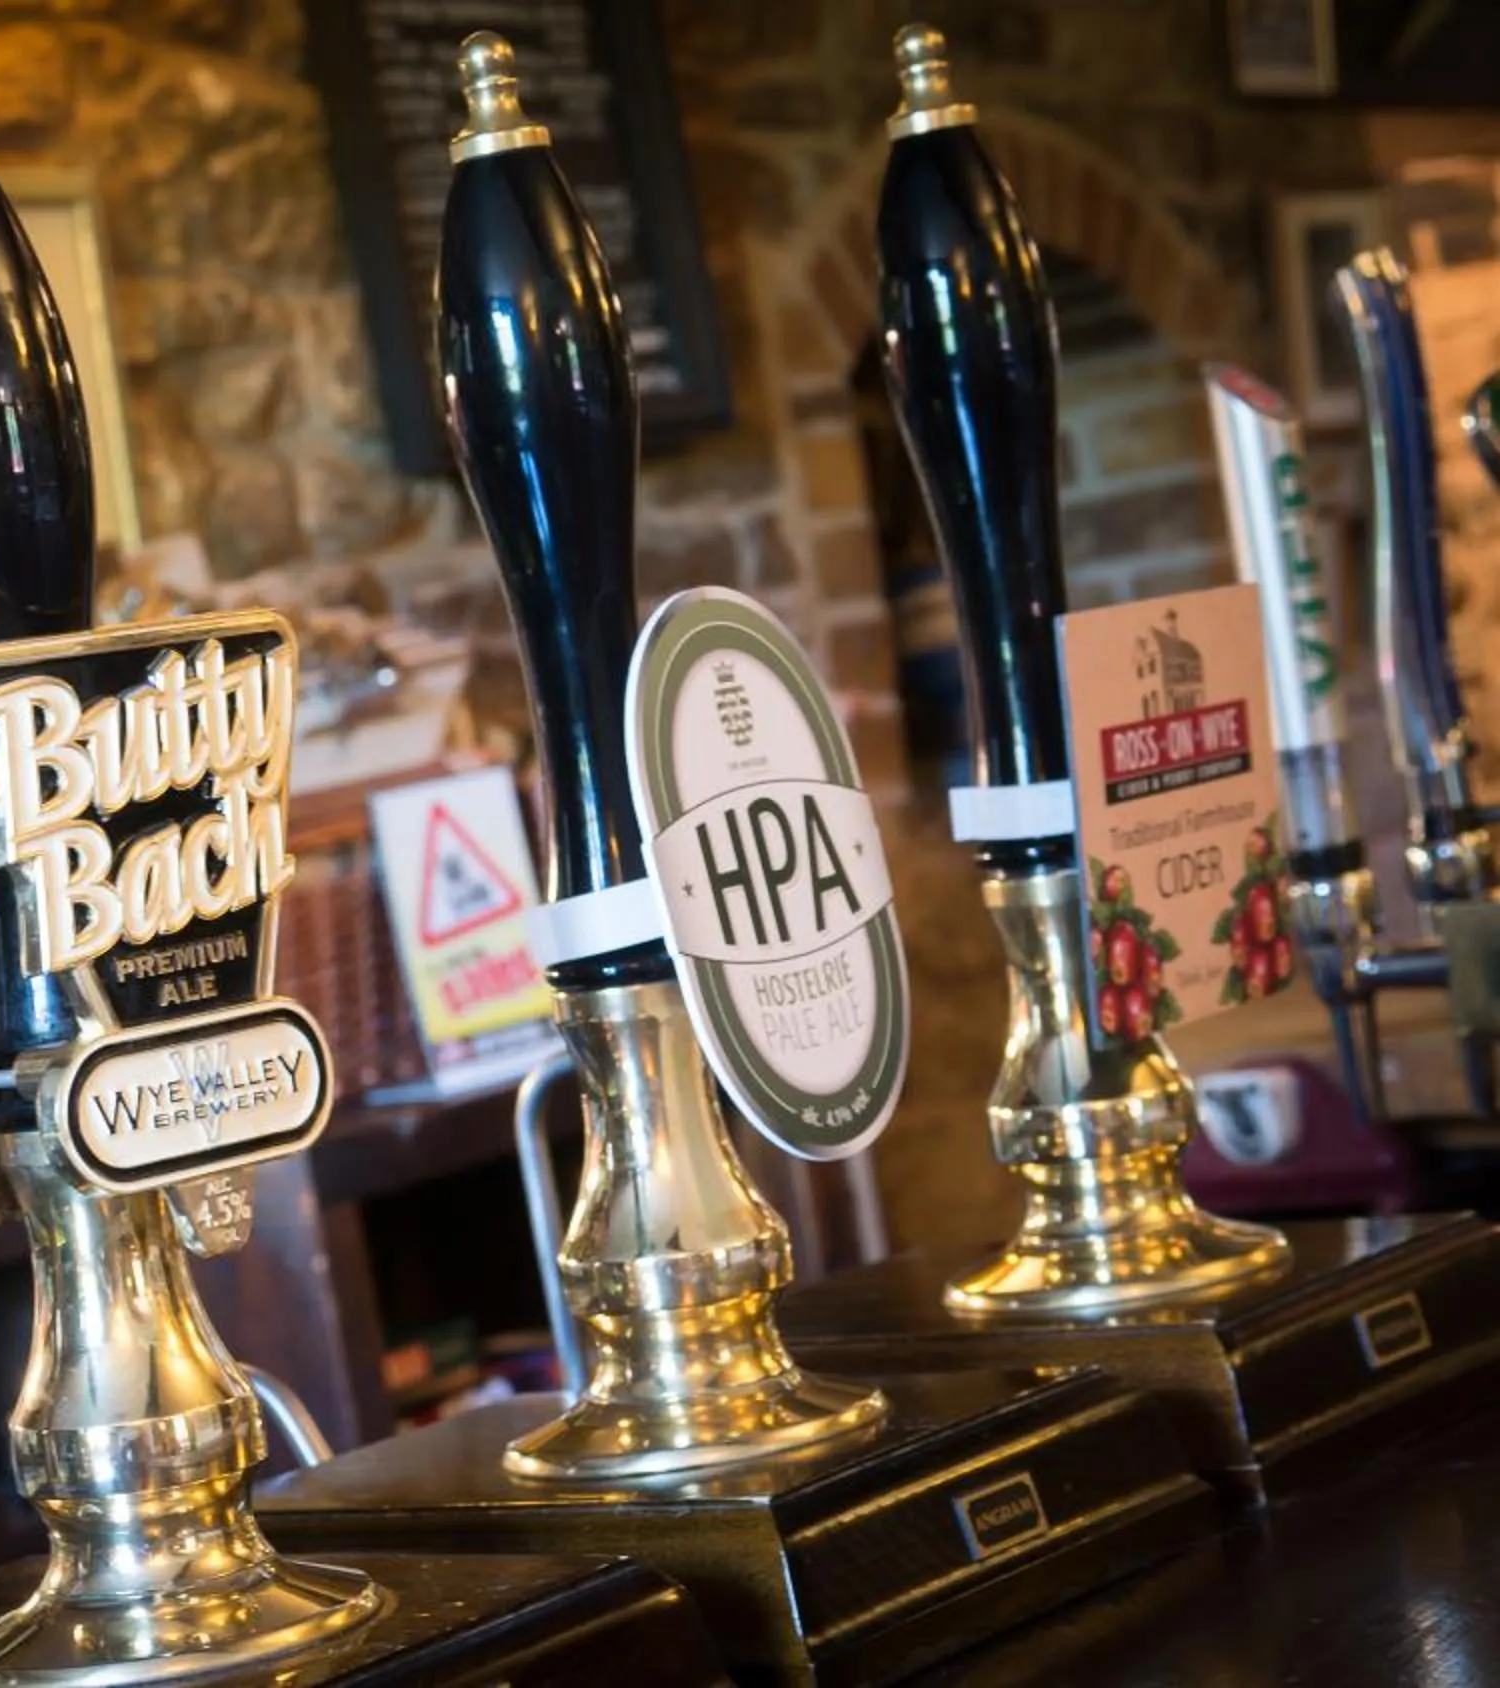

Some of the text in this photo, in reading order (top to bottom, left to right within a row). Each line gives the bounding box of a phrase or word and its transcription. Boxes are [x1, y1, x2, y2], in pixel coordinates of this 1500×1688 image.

[17, 784, 296, 972] Bach
[696, 794, 862, 947] HPA
[1156, 845, 1225, 899] CIDER
[115, 930, 248, 984] PREMIUM
[754, 951, 854, 1009] HOSTELRIE
[159, 973, 219, 1007] ALE
[761, 989, 866, 1053] PALE ALE
[94, 1049, 303, 1136] WYE VALLEY
[153, 1086, 283, 1129] BREWERY
[194, 1190, 252, 1229] 4.5%
